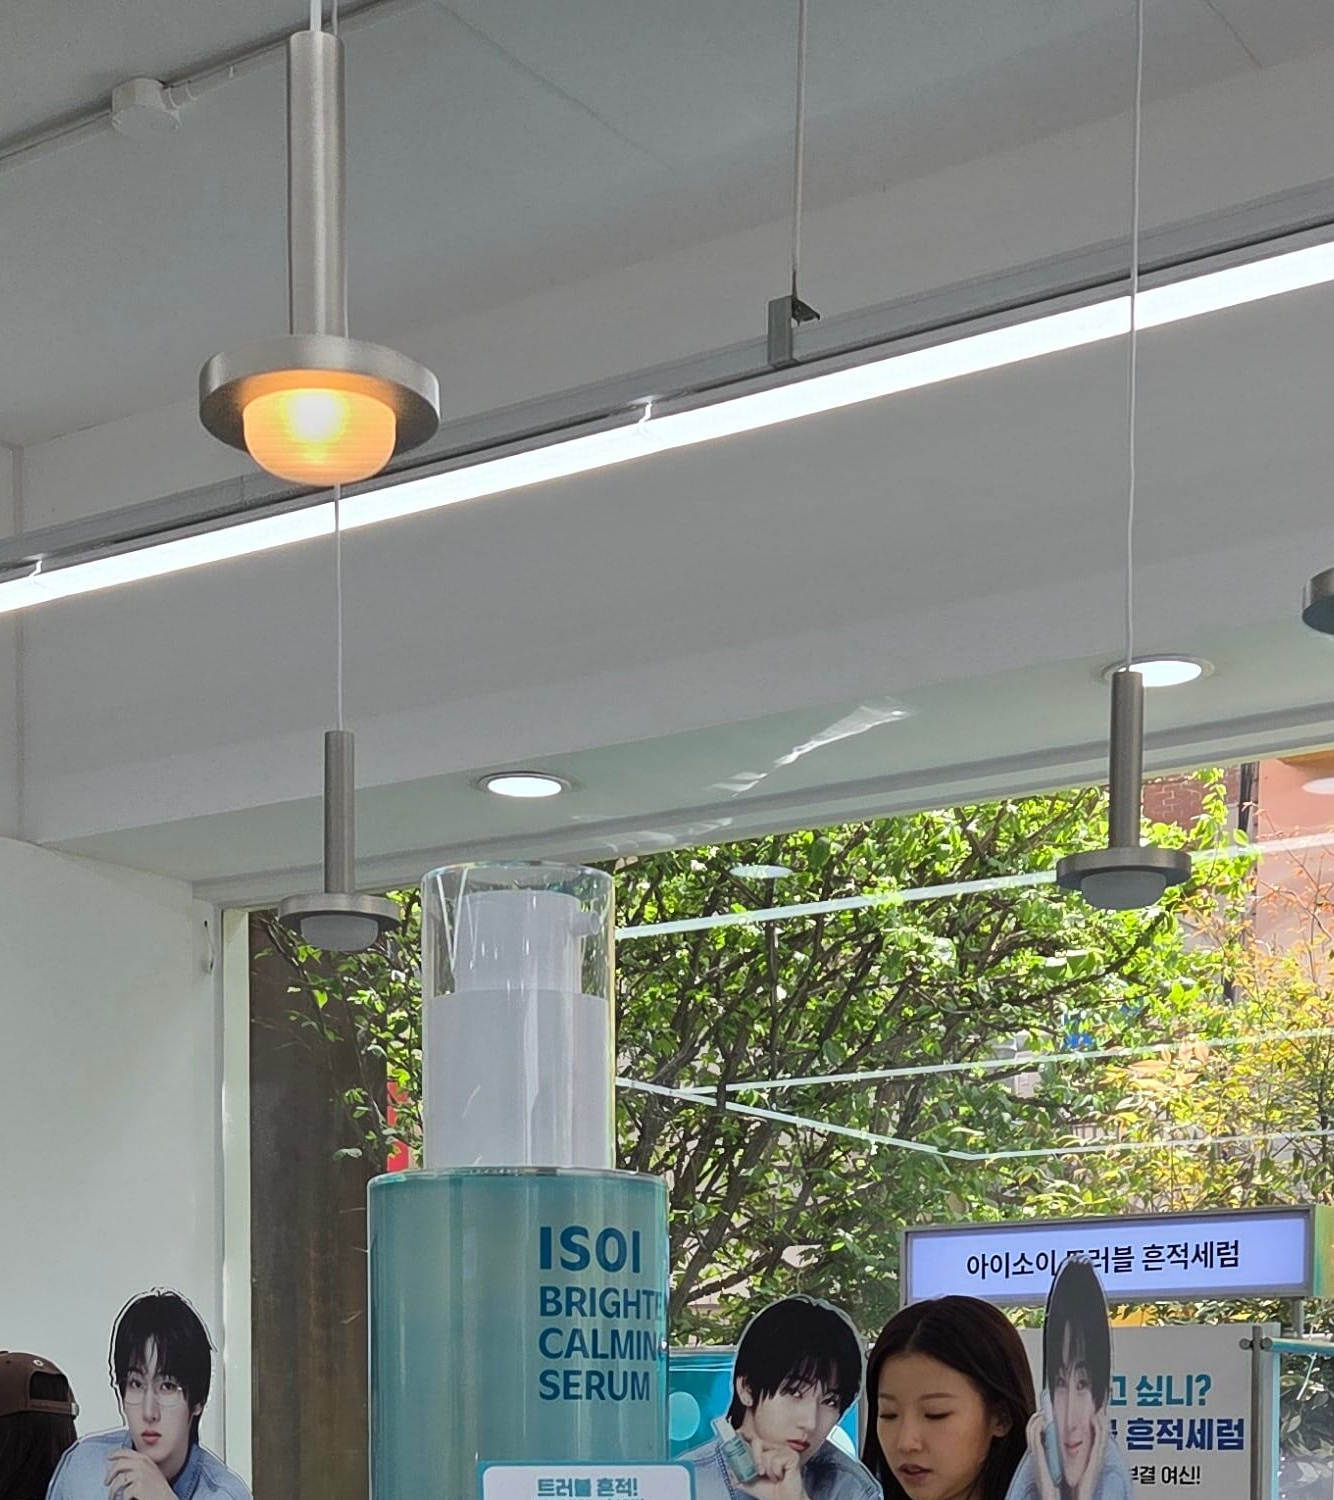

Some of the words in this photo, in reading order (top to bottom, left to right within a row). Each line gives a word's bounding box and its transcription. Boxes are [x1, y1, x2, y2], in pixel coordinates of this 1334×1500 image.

[539, 1225, 641, 1274] ISOI
[967, 1249, 1057, 1280] 아이소이
[1142, 1239, 1240, 1272] 흔적세럼
[538, 1369, 650, 1401] SERUM
[1135, 1374, 1212, 1407] 싶니?
[1126, 1418, 1245, 1451] 흔적세럼
[537, 1478, 592, 1498] 트러블
[596, 1477, 638, 1497] 흔적!
[1161, 1466, 1202, 1485] 여신!
